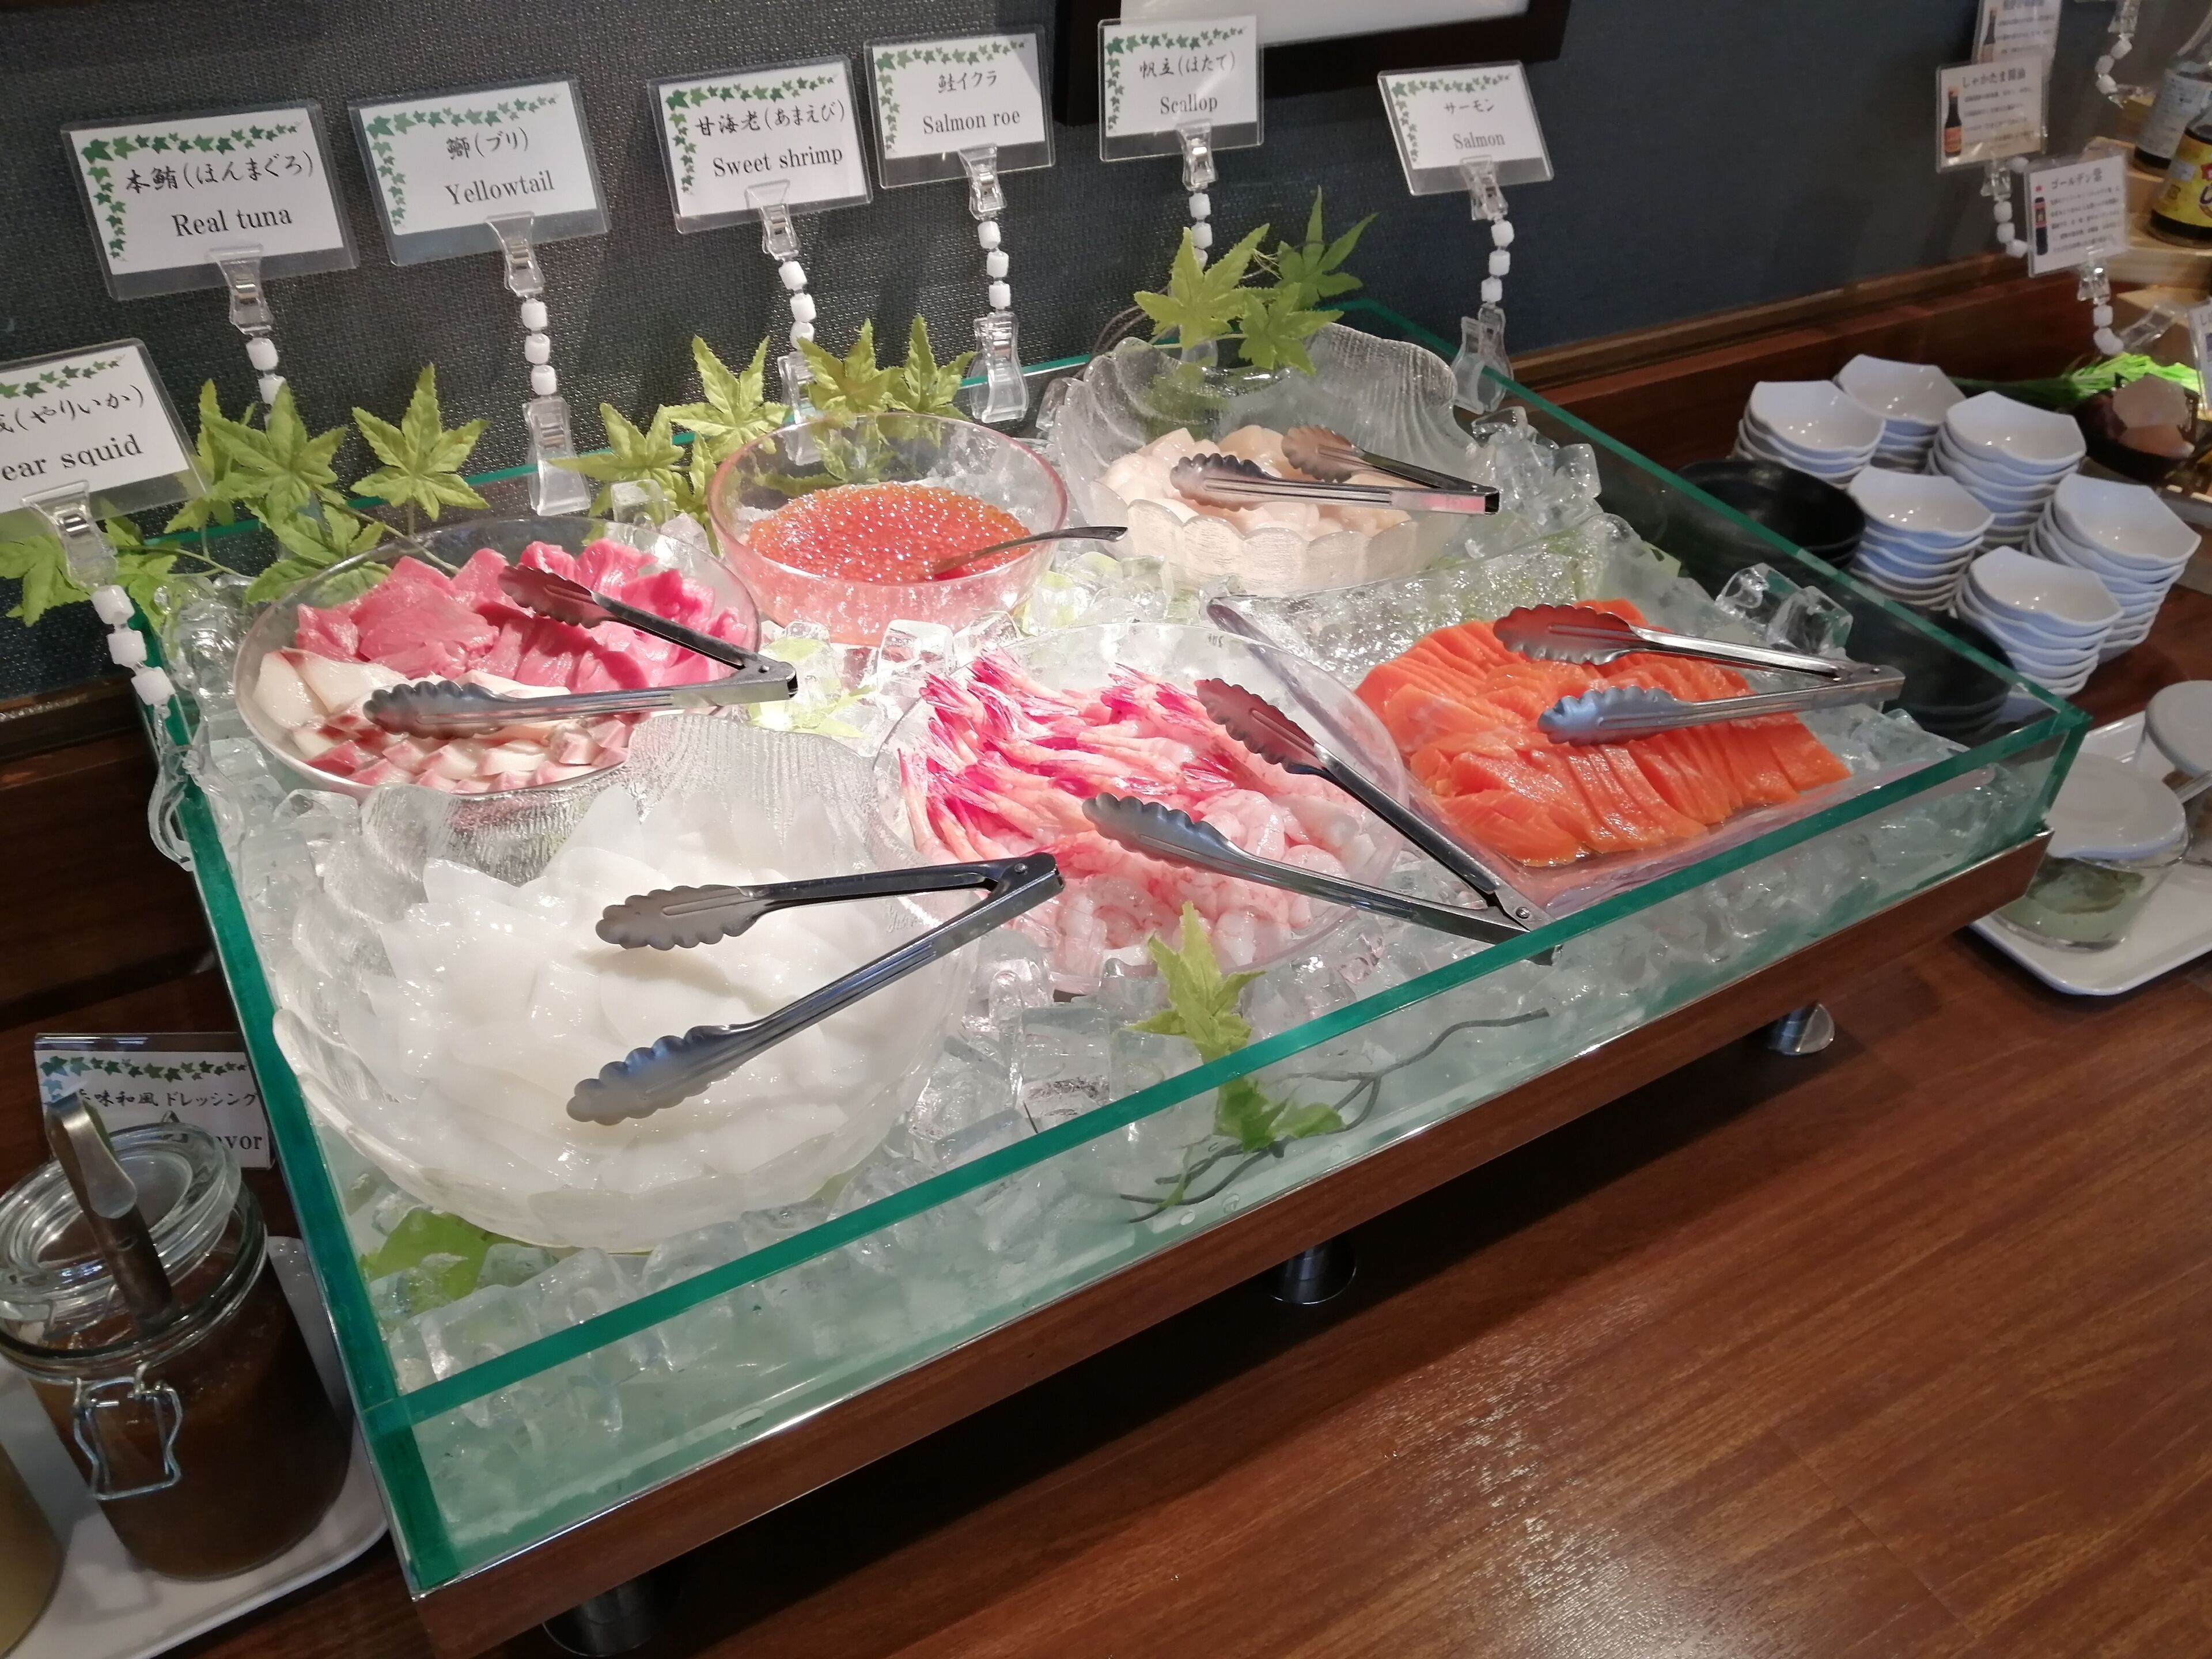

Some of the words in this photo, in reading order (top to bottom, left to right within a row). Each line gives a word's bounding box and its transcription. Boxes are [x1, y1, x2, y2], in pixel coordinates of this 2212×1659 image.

[1139, 51, 1236, 79] 帆立(ほたて)
[938, 70, 998, 94] 鮭イクラ
[696, 100, 845, 136] 甘海老(あまえび)
[1160, 93, 1218, 115] Scallop
[1444, 99, 1495, 113] サーモン
[923, 114, 986, 134] Salmon
[993, 111, 1021, 125] roe
[1453, 134, 1506, 149] Salmon
[126, 151, 315, 194] 本鮪(ほんまぐろ)
[713, 156, 772, 178] Sweet
[779, 145, 843, 168] shrimp
[445, 170, 555, 206] Yellowtail
[172, 210, 228, 237] Real
[238, 207, 293, 228] tuna
[60, 434, 144, 468] squid
[215, 1135, 263, 1150] vor
